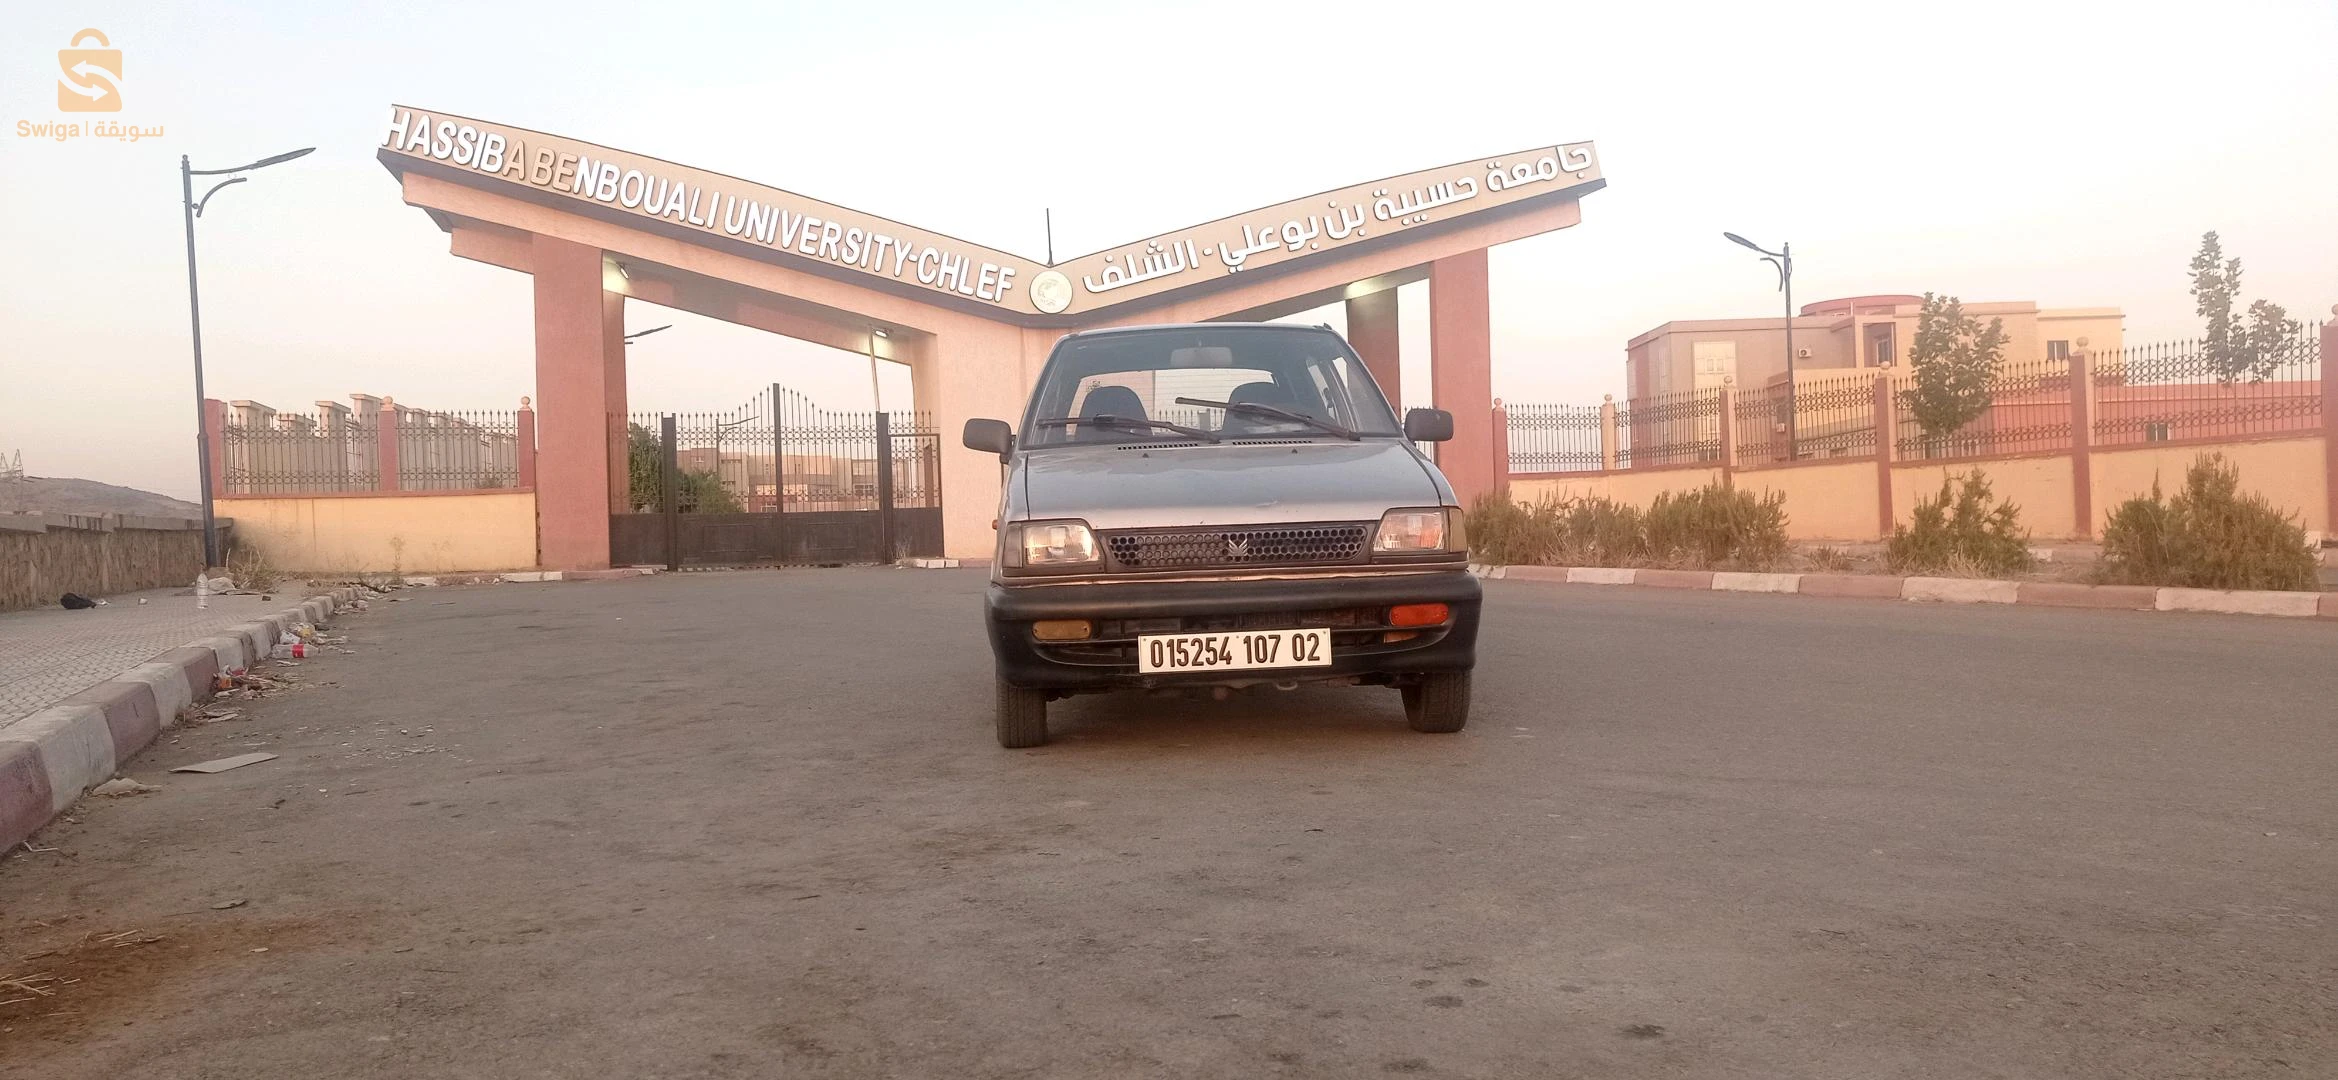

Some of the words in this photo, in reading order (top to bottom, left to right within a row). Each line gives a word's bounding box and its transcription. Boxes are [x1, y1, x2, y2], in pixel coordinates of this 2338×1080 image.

[381, 107, 526, 181] HASSIBA
[530, 146, 721, 229] BENBOUALI
[1486, 145, 1594, 192] جامعة
[1323, 200, 1366, 240] بن
[1373, 175, 1480, 226] حسيبة
[1082, 239, 1200, 294] الشلف
[1150, 636, 1232, 668] 015254
[1243, 634, 1281, 664] 107
[1291, 632, 1320, 662] 02
